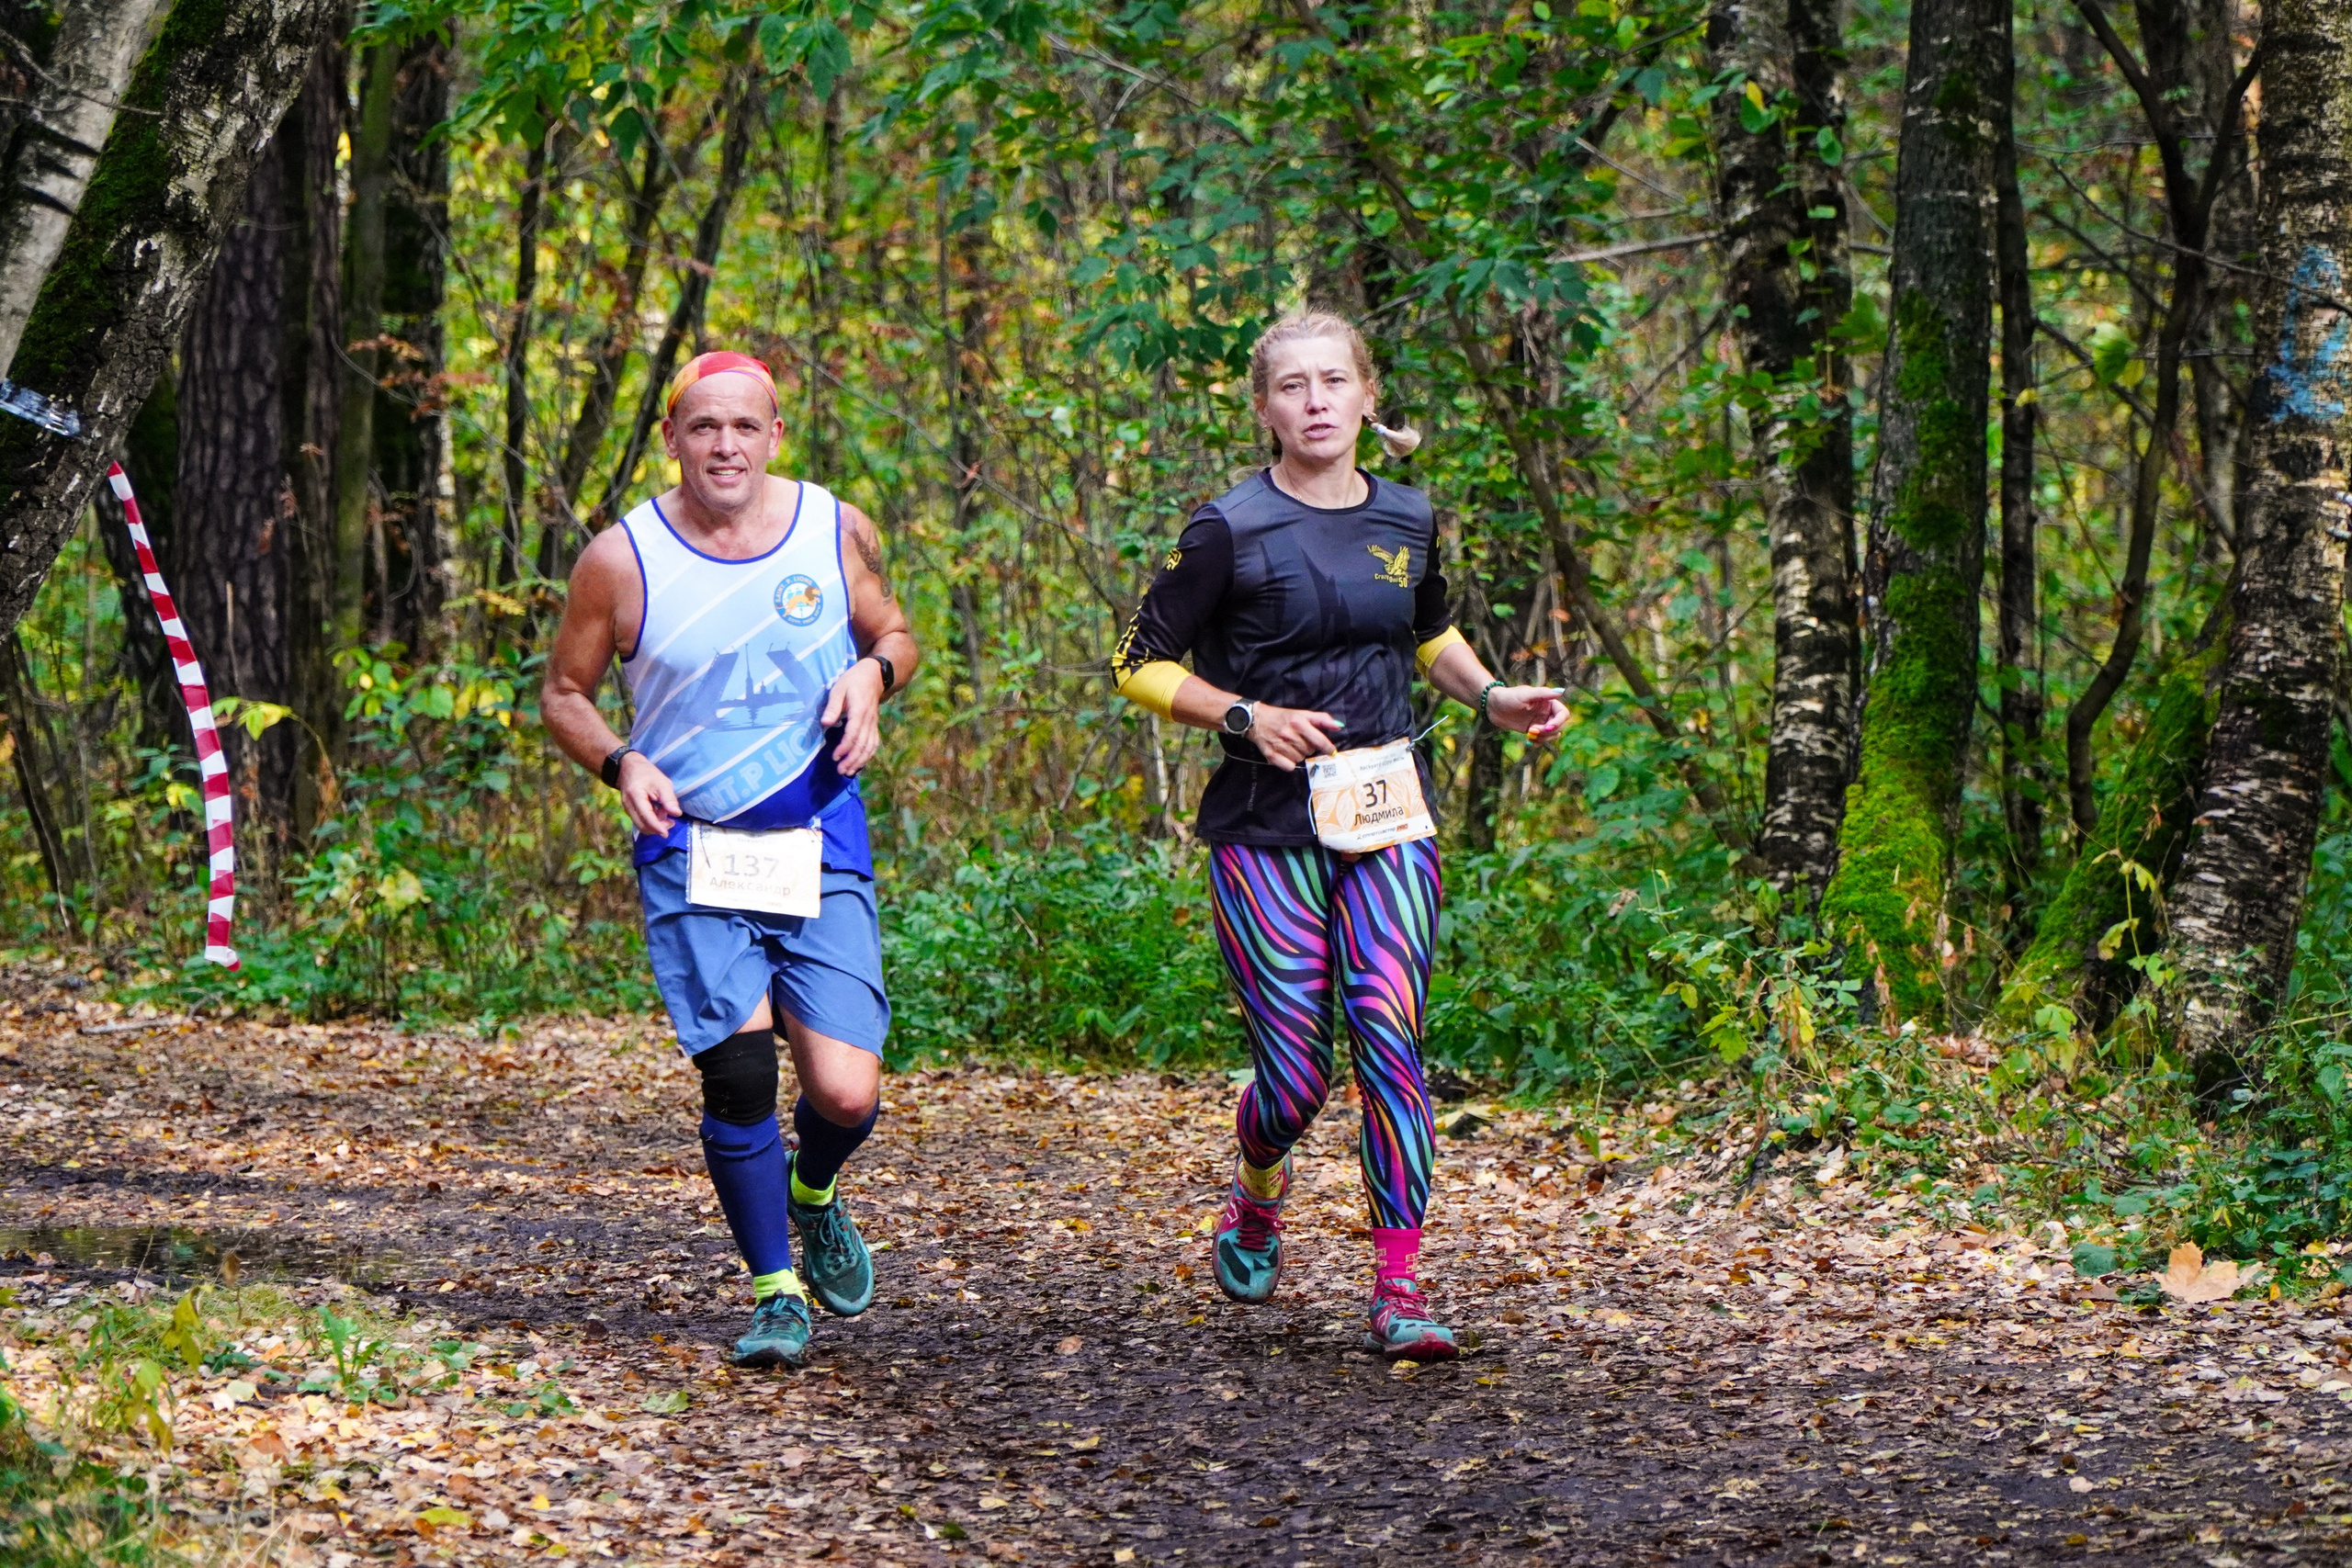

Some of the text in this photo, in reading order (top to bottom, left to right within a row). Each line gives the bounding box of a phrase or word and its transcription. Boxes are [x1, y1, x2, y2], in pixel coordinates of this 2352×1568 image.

[1363, 779, 1387, 808] 37
[1354, 807, 1404, 827] Людмила
[723, 853, 780, 878] 137
[709, 876, 792, 897] Александр
